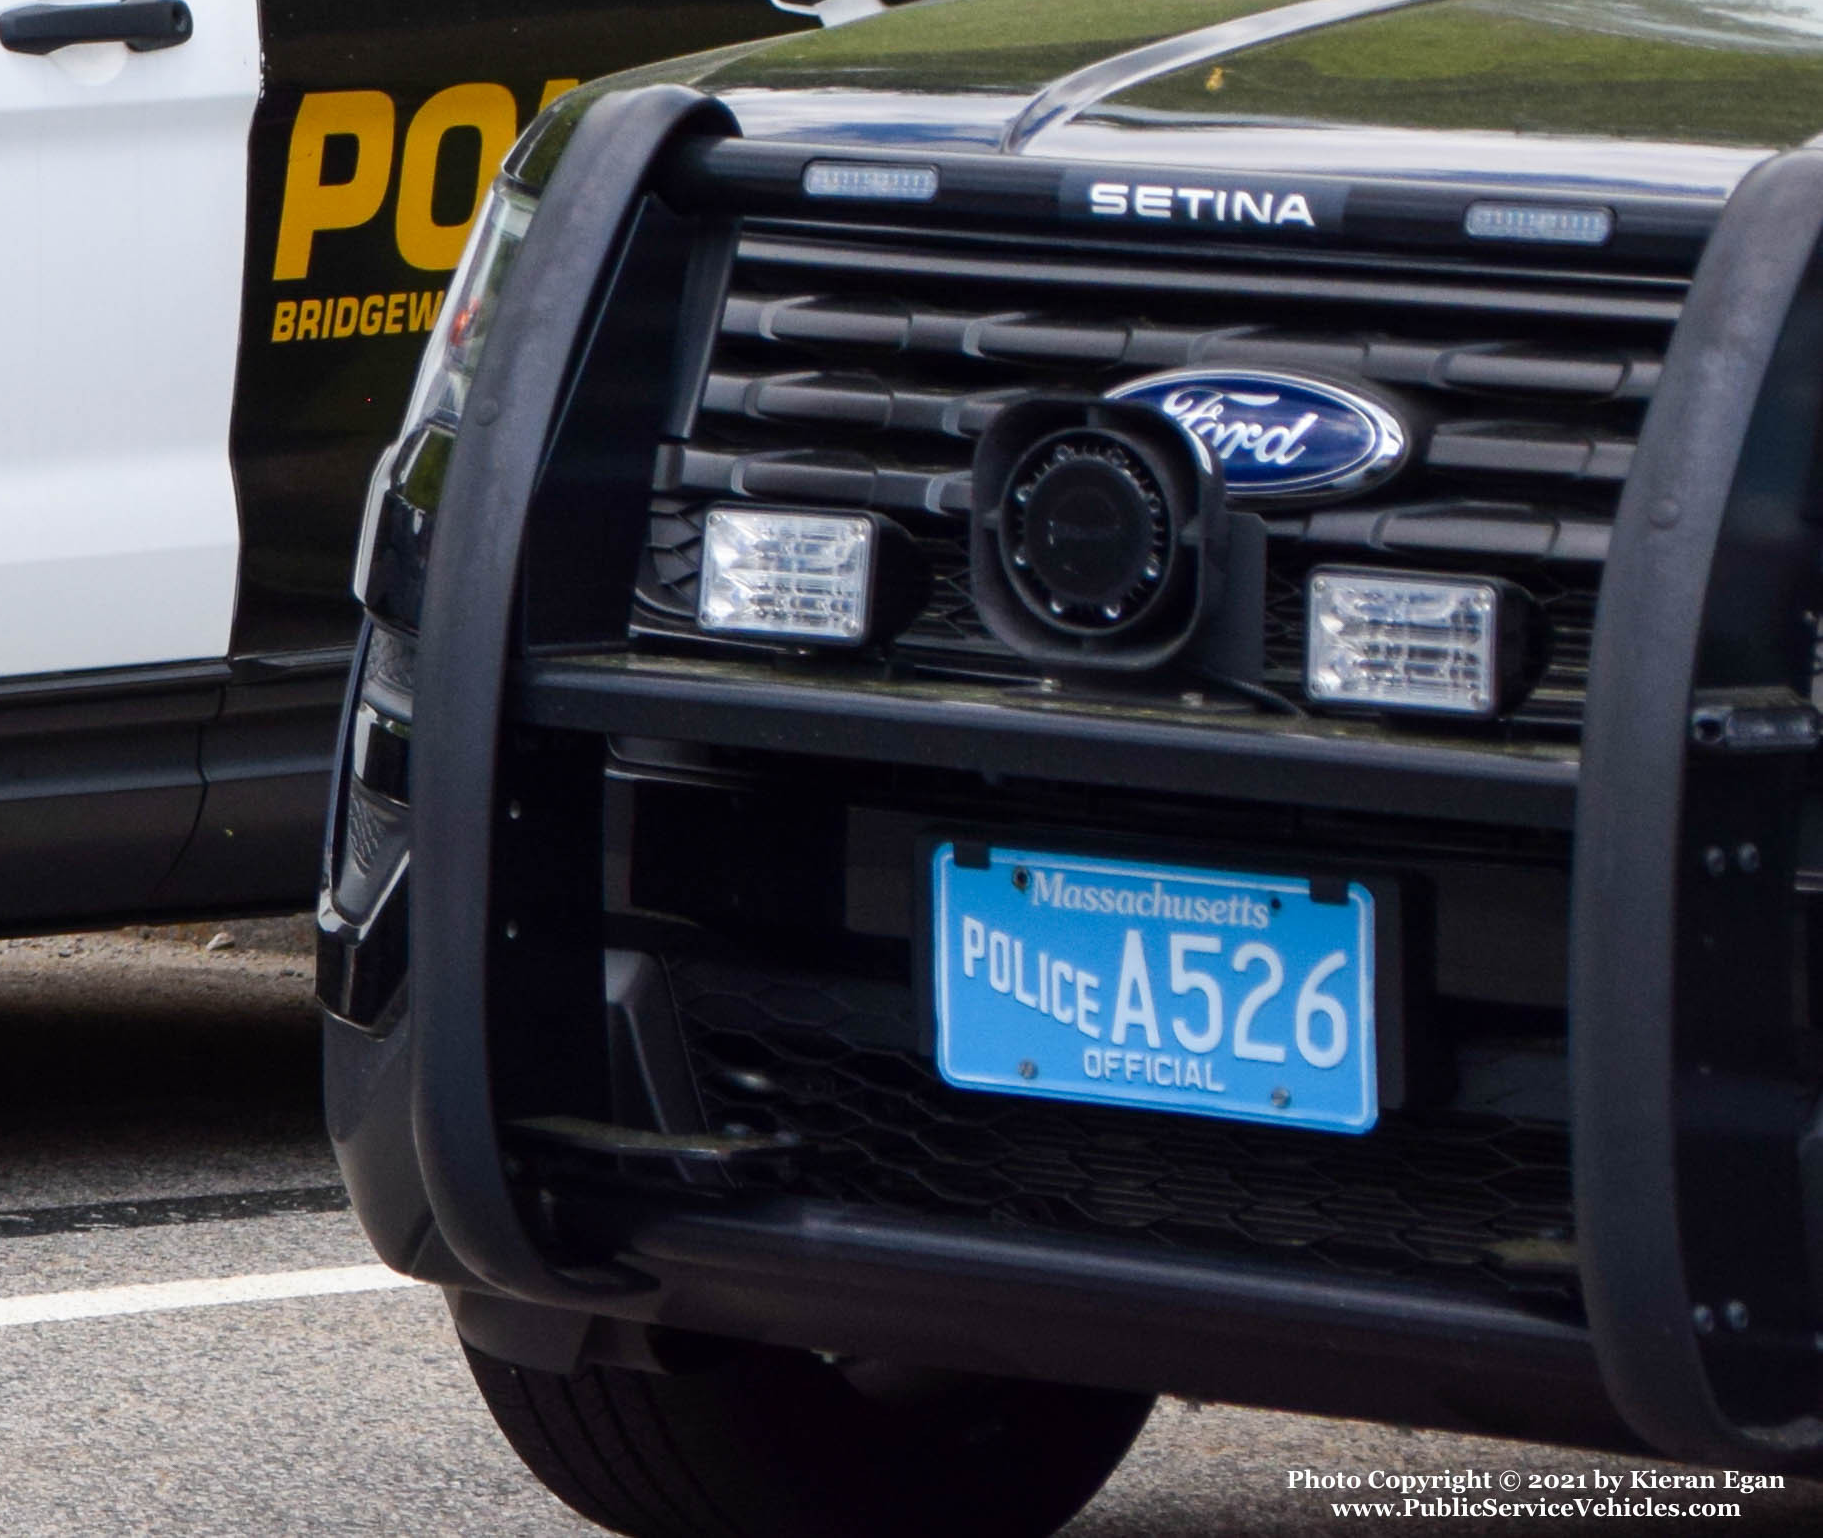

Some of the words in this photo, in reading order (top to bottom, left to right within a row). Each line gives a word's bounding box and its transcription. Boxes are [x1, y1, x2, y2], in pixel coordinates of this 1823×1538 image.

[1089, 183, 1315, 227] SETINA
[1031, 870, 1270, 928] Massachusetts
[962, 914, 1102, 1040] POLICE
[1111, 929, 1349, 1069] A526
[1083, 1047, 1226, 1093] OFFICIAL
